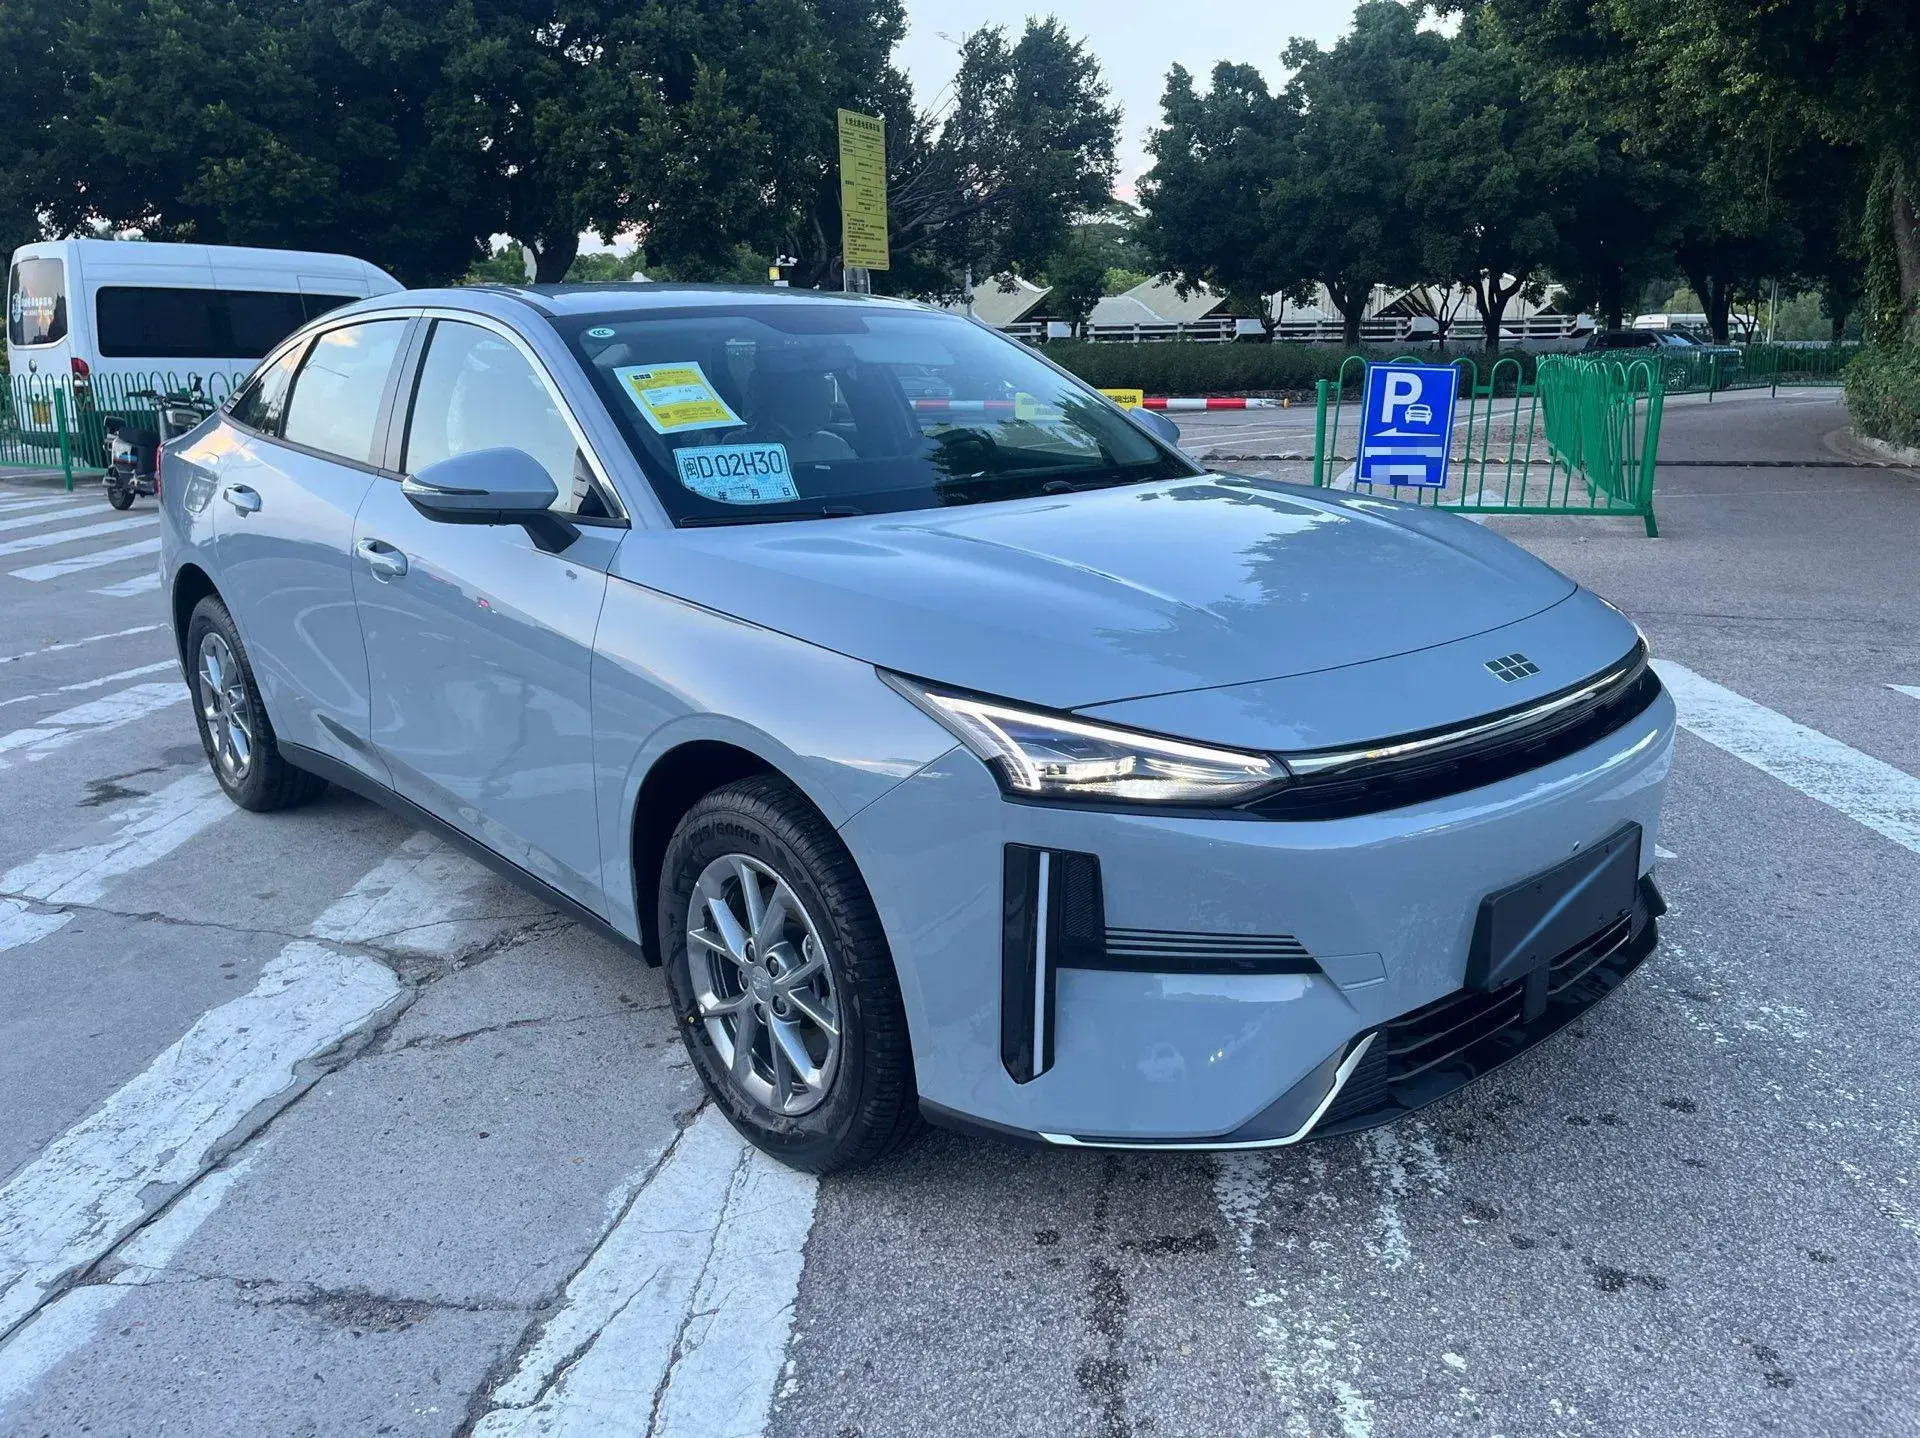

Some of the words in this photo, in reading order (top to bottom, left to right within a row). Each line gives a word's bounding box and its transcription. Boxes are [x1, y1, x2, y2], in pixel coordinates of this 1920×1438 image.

[1381, 371, 1423, 423] P
[751, 488, 761, 500] 月
[782, 486, 791, 497] 日
